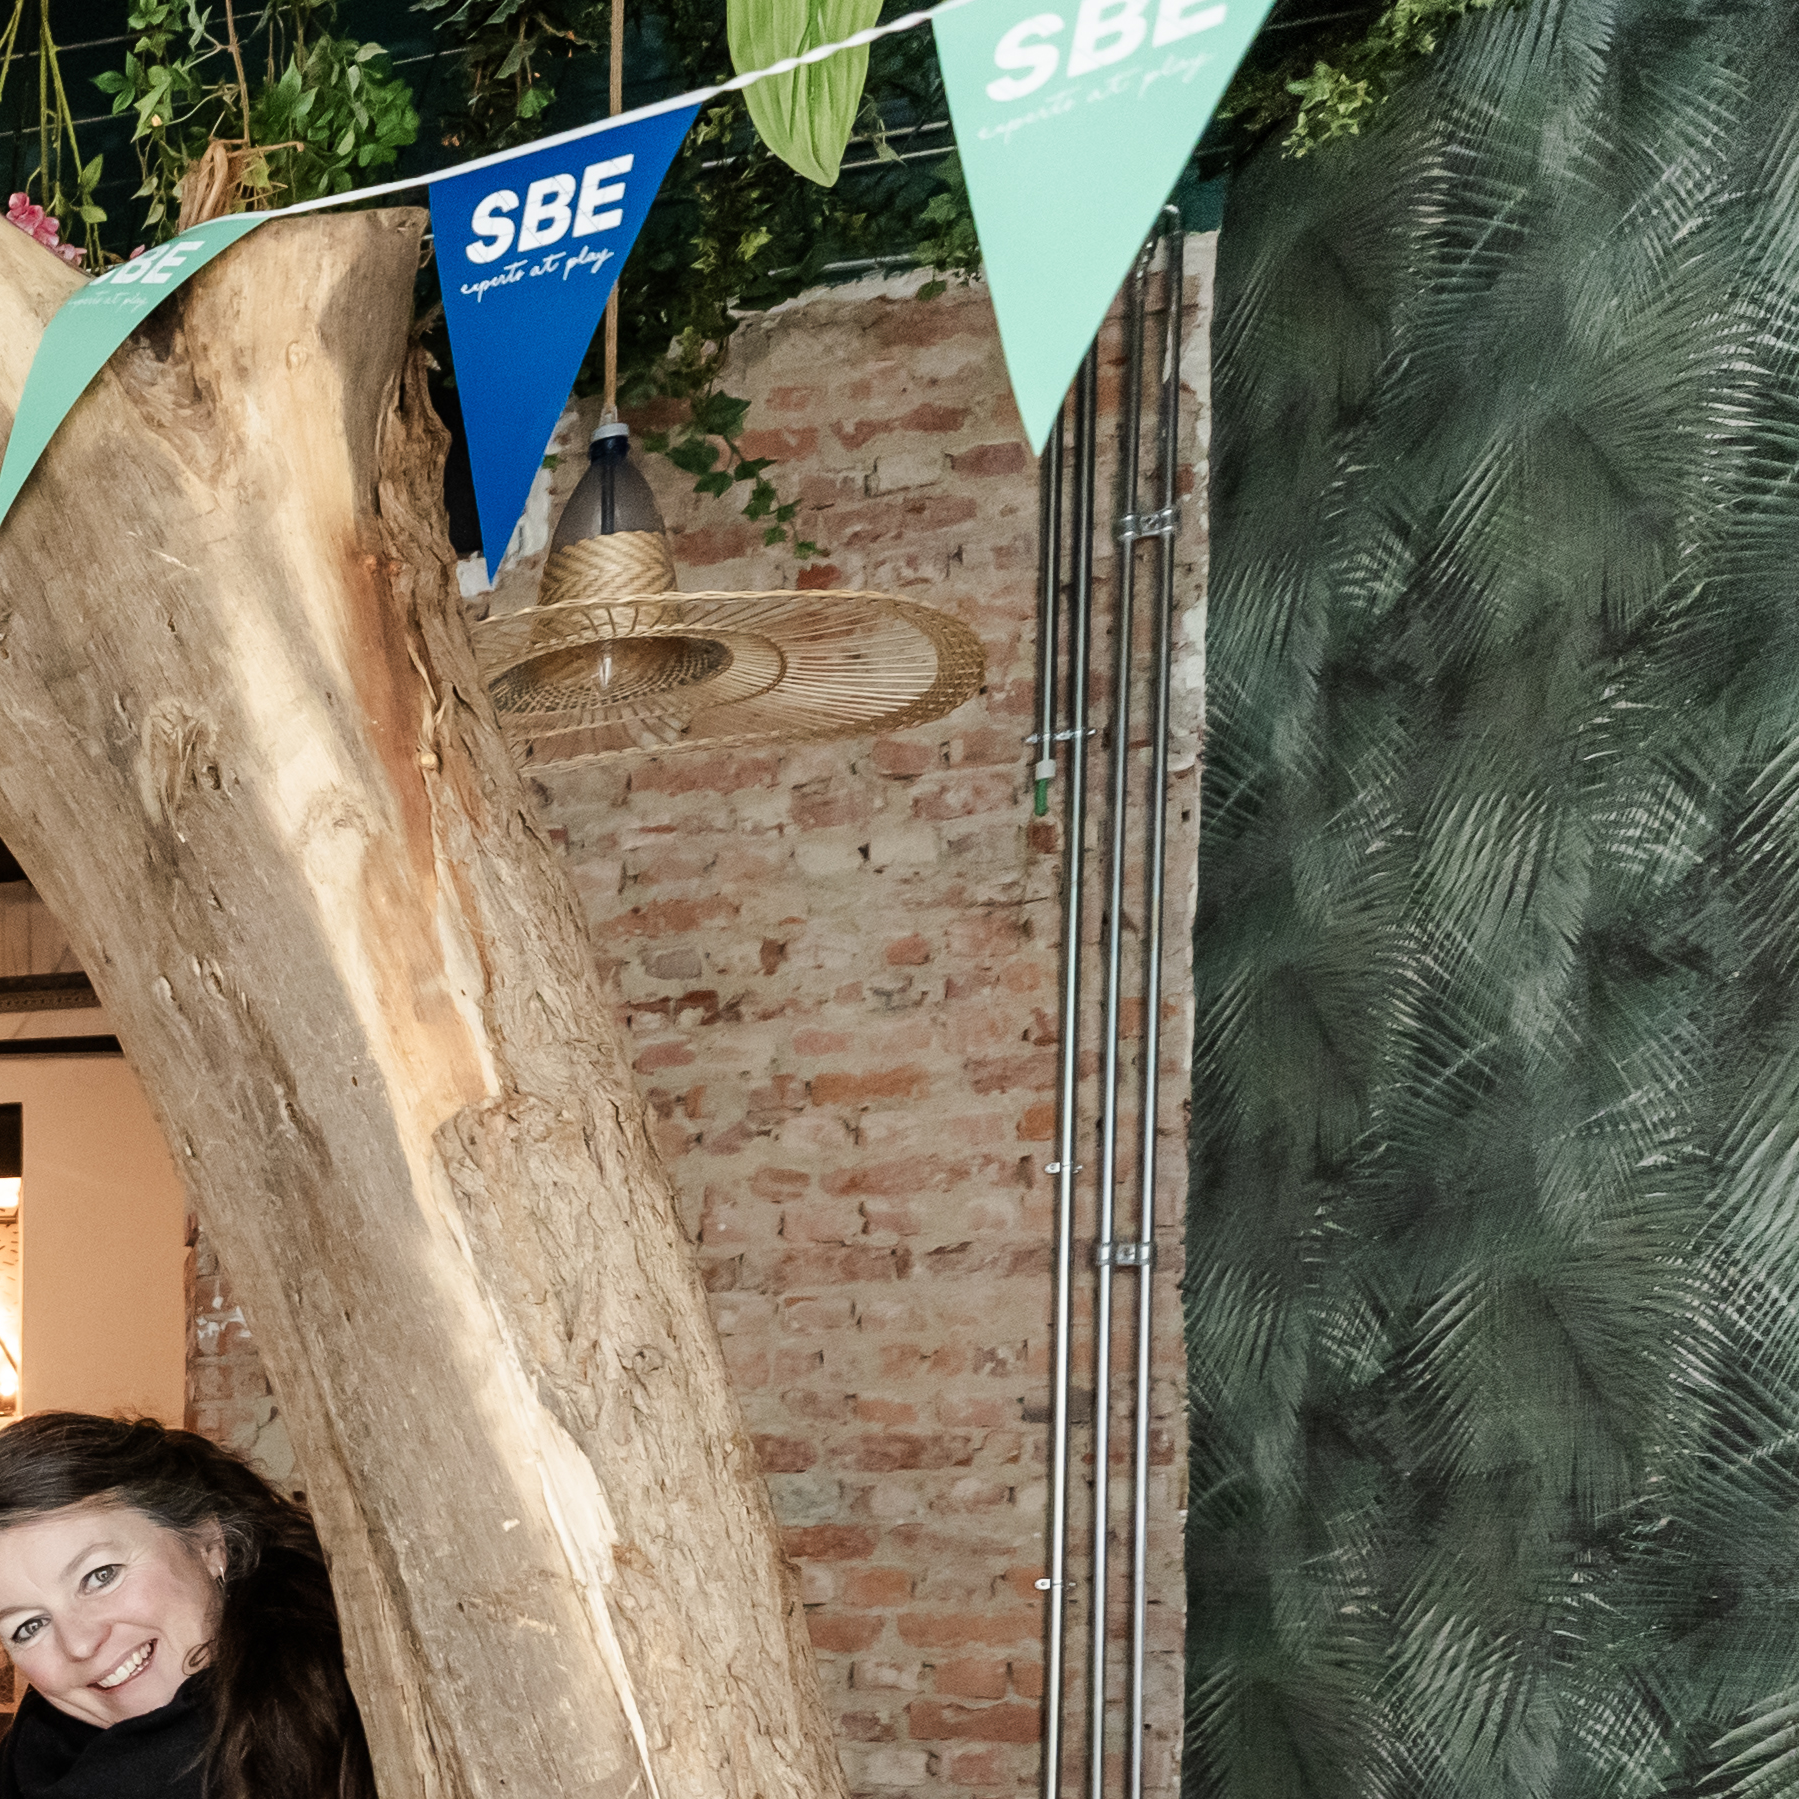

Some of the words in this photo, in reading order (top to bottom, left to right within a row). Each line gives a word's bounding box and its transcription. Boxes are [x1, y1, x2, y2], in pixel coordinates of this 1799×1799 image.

[465, 153, 635, 265] SBE
[460, 259, 528, 303] experts
[529, 251, 567, 277] at
[563, 245, 615, 281] play
